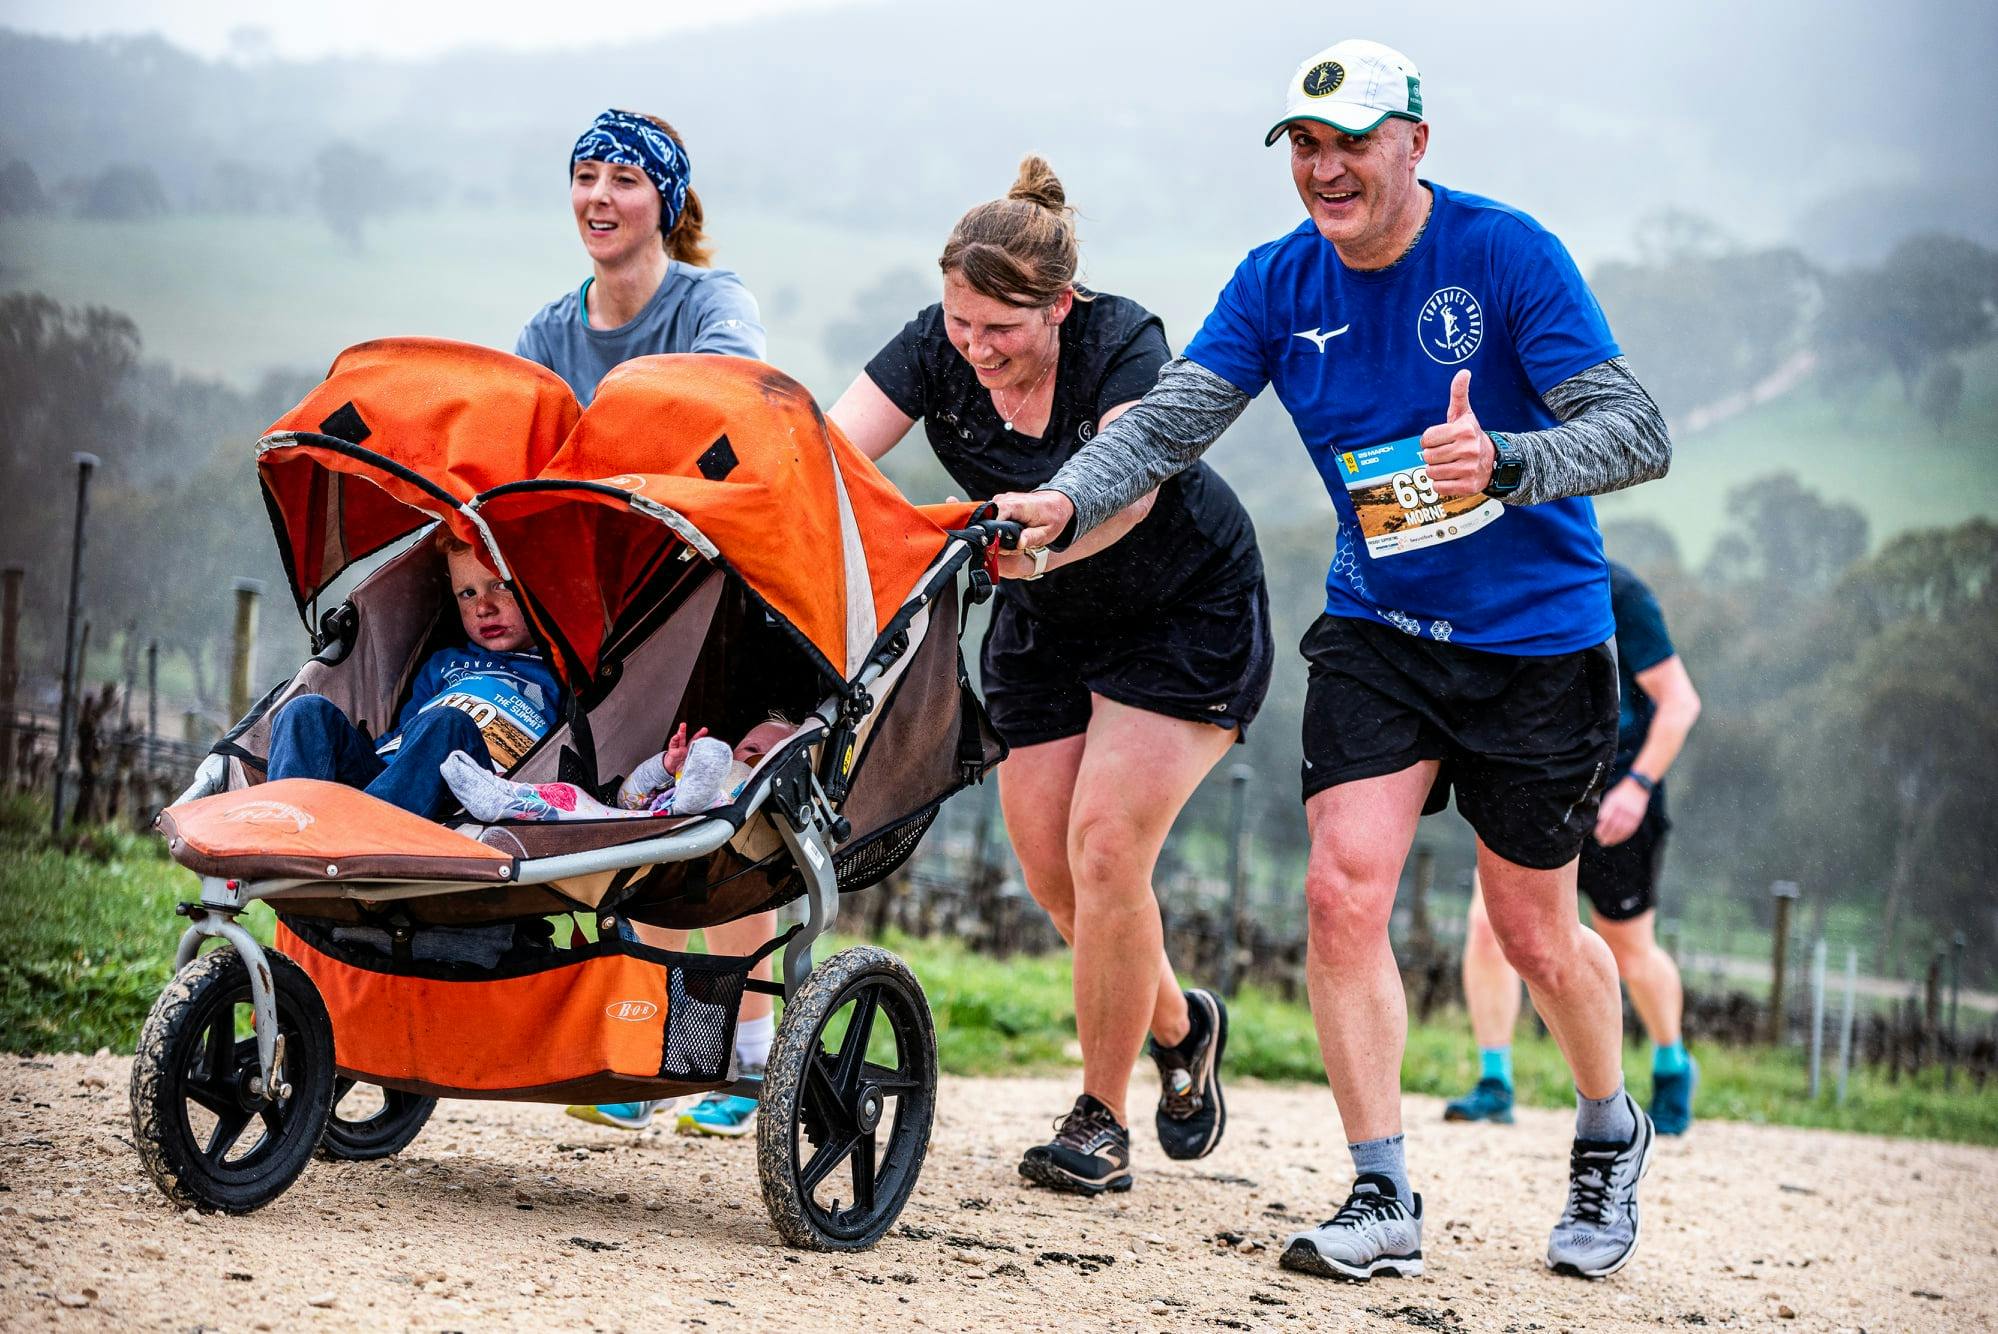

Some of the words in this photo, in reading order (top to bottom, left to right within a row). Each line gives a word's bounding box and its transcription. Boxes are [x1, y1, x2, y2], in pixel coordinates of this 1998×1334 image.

[1404, 504, 1447, 526] MORNE
[493, 693, 511, 708] THE
[510, 705, 542, 730] SUMMIT
[510, 695, 546, 726] CONQUER
